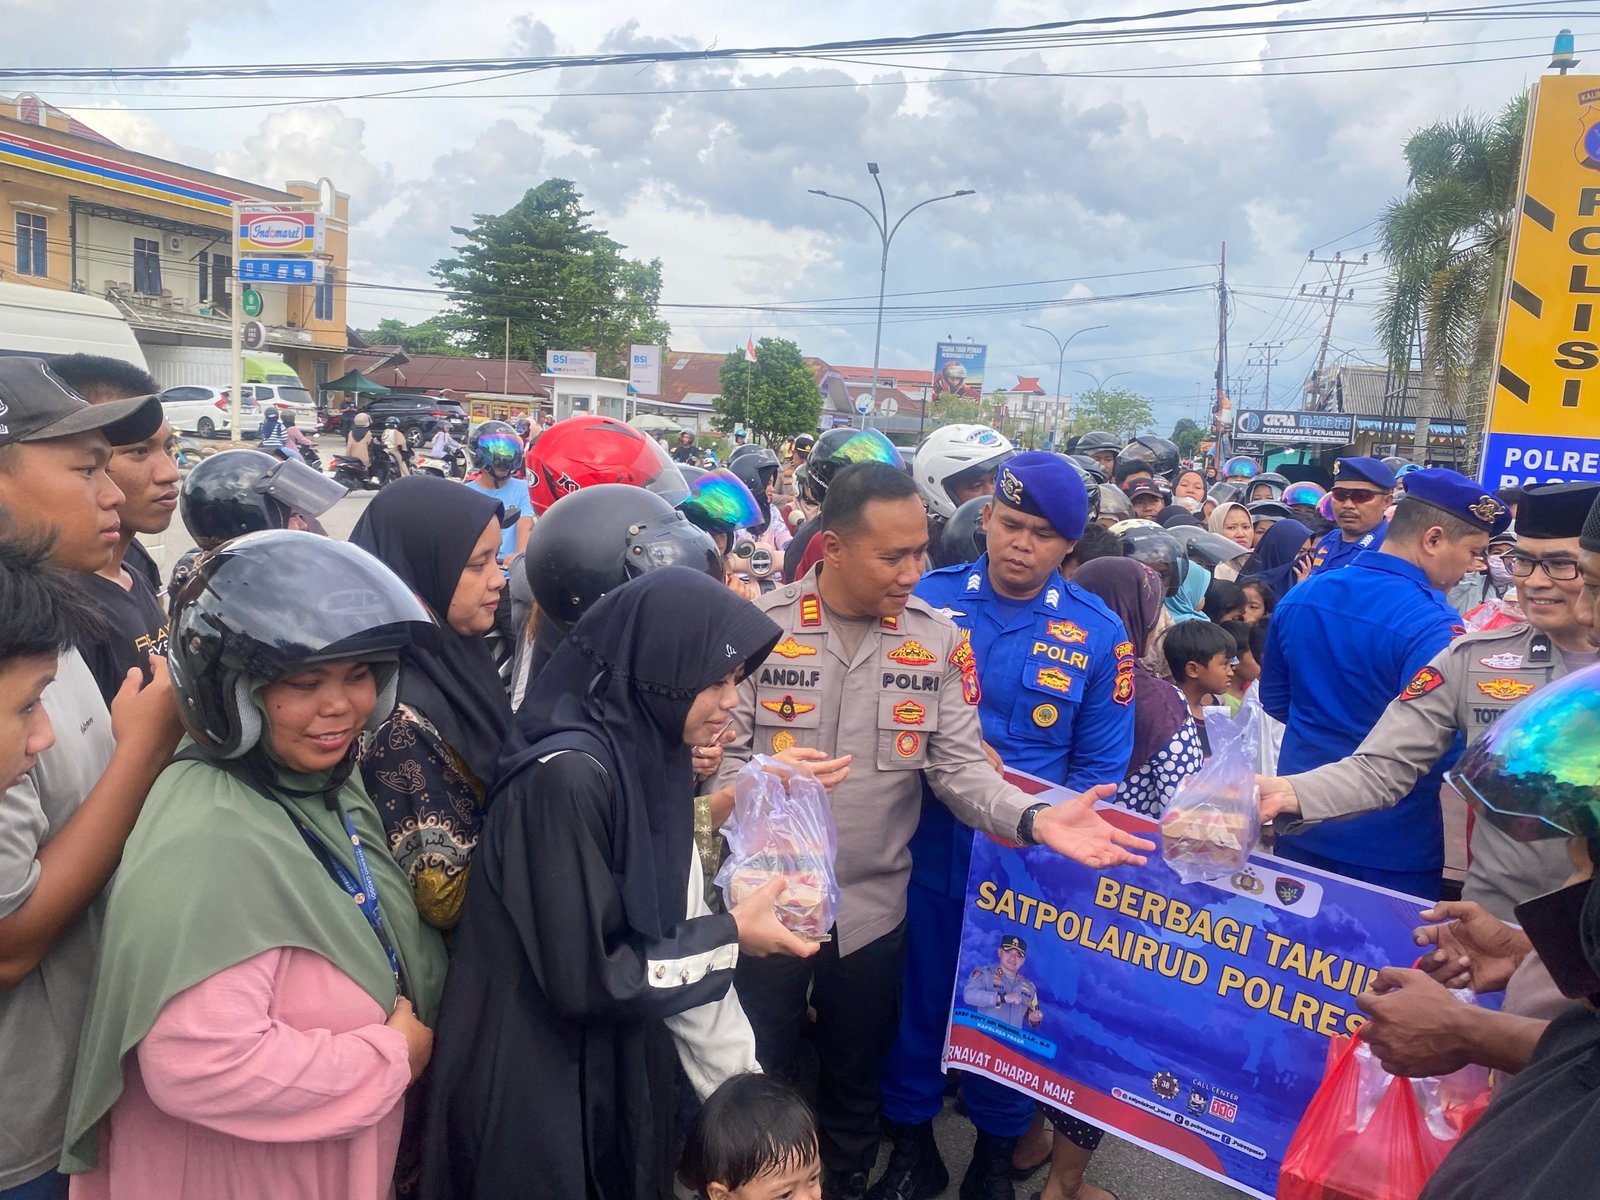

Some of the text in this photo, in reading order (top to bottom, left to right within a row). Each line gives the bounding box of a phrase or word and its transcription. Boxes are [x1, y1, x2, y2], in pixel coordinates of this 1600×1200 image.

[252, 224, 300, 239] Indomaret
[553, 354, 568, 364] BSI
[634, 355, 648, 363] BSI
[1263, 413, 1296, 427] CITRA
[1262, 427, 1304, 435] PERCETAKAN
[1313, 429, 1350, 437] PENJILIDAN
[1032, 641, 1089, 670] POLRI
[760, 668, 820, 688] ANDI.F
[882, 672, 939, 692] POLRI
[1473, 707, 1506, 724] TOT
[1094, 876, 1254, 956] BERBAGI
[976, 880, 1209, 986] SATPOLAIRUD
[977, 1022, 1025, 1045] KAPOLRES PASER
[994, 1058, 1040, 1090] DHARPA
[1042, 1080, 1075, 1105] MAHE
[1192, 1078, 1239, 1102] CALL CENTER
[1212, 1101, 1234, 1119] 110
